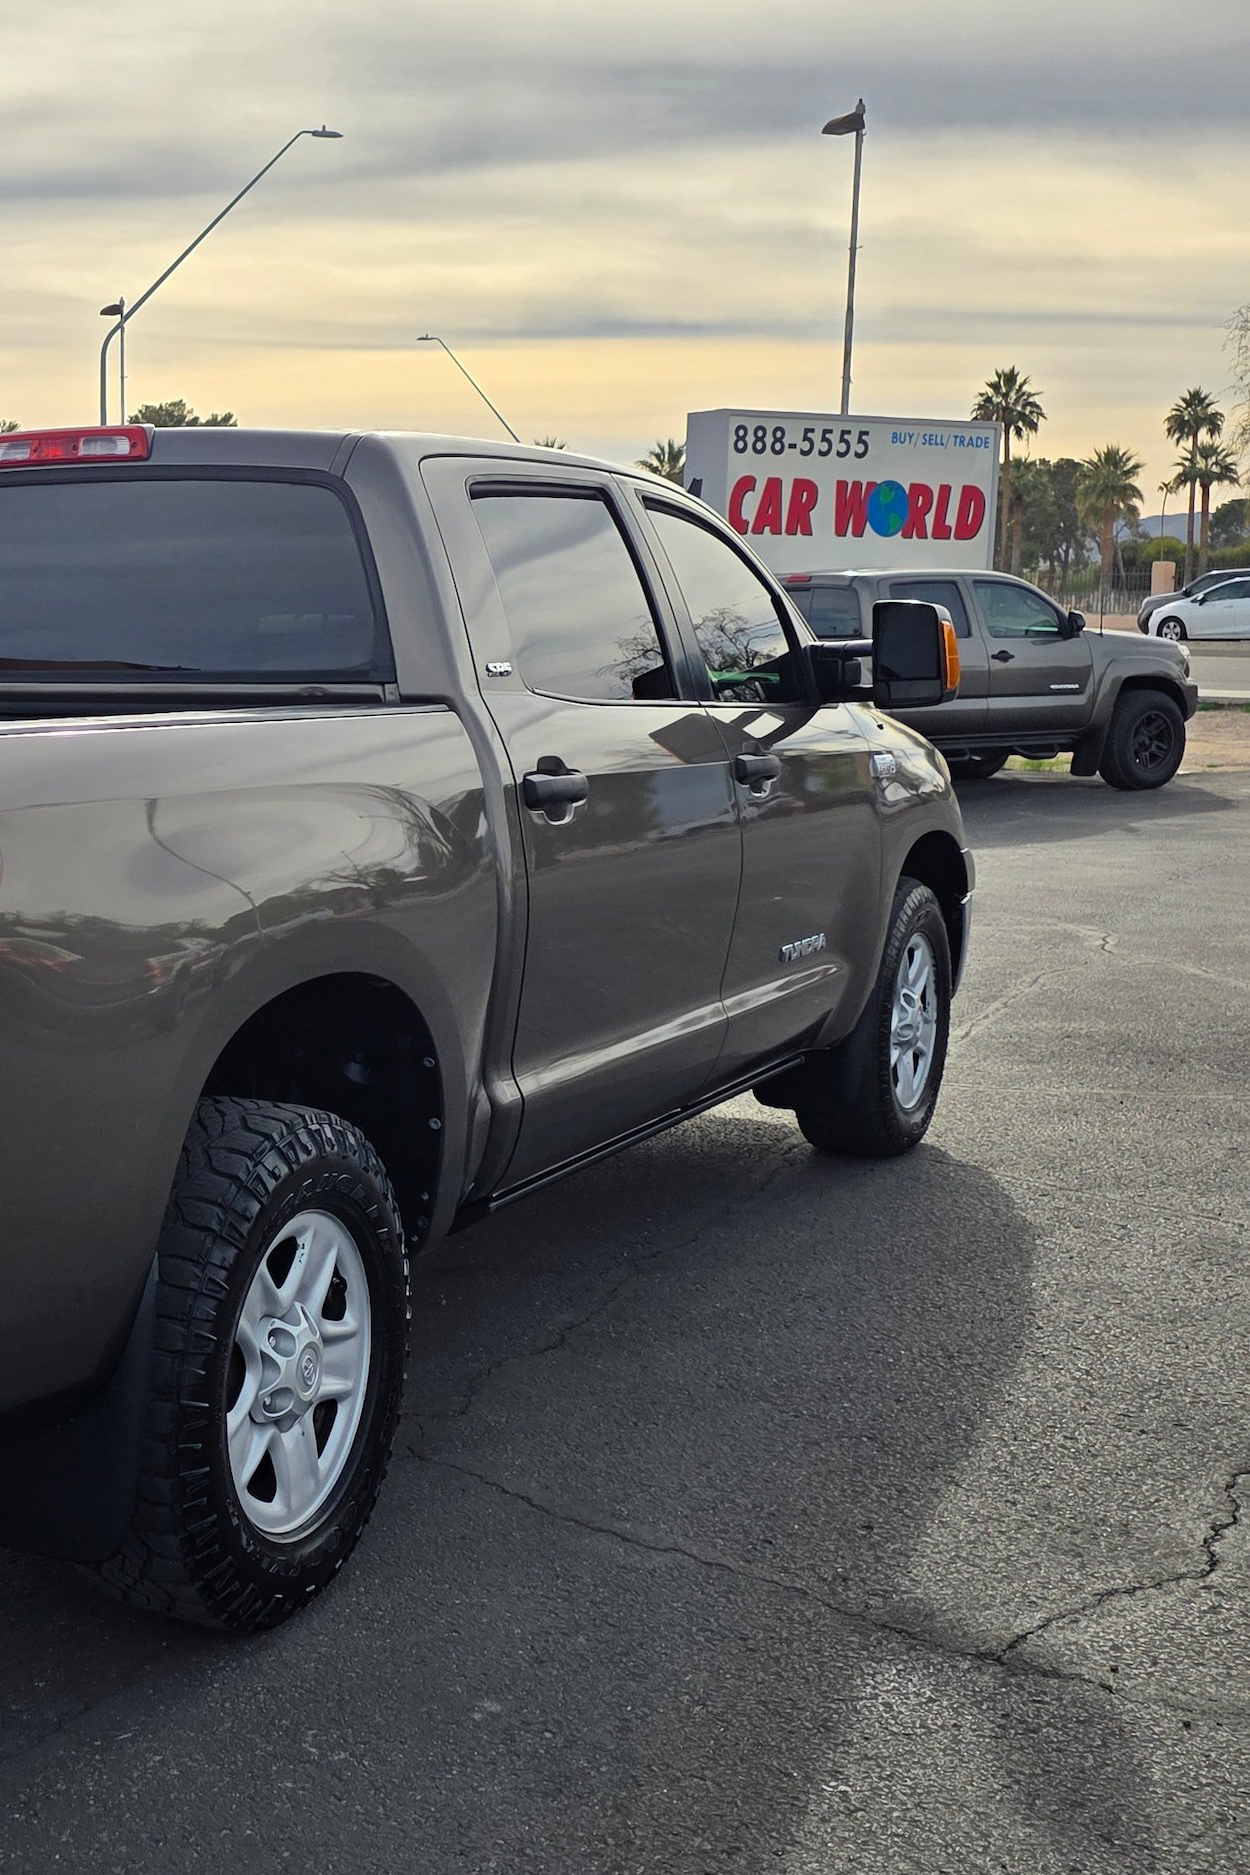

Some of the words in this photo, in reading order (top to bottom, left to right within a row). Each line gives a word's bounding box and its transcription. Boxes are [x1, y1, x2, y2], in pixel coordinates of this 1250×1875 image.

[733, 424, 870, 459] 888-5555
[728, 475, 819, 536] CAR
[834, 480, 986, 541] WORLD
